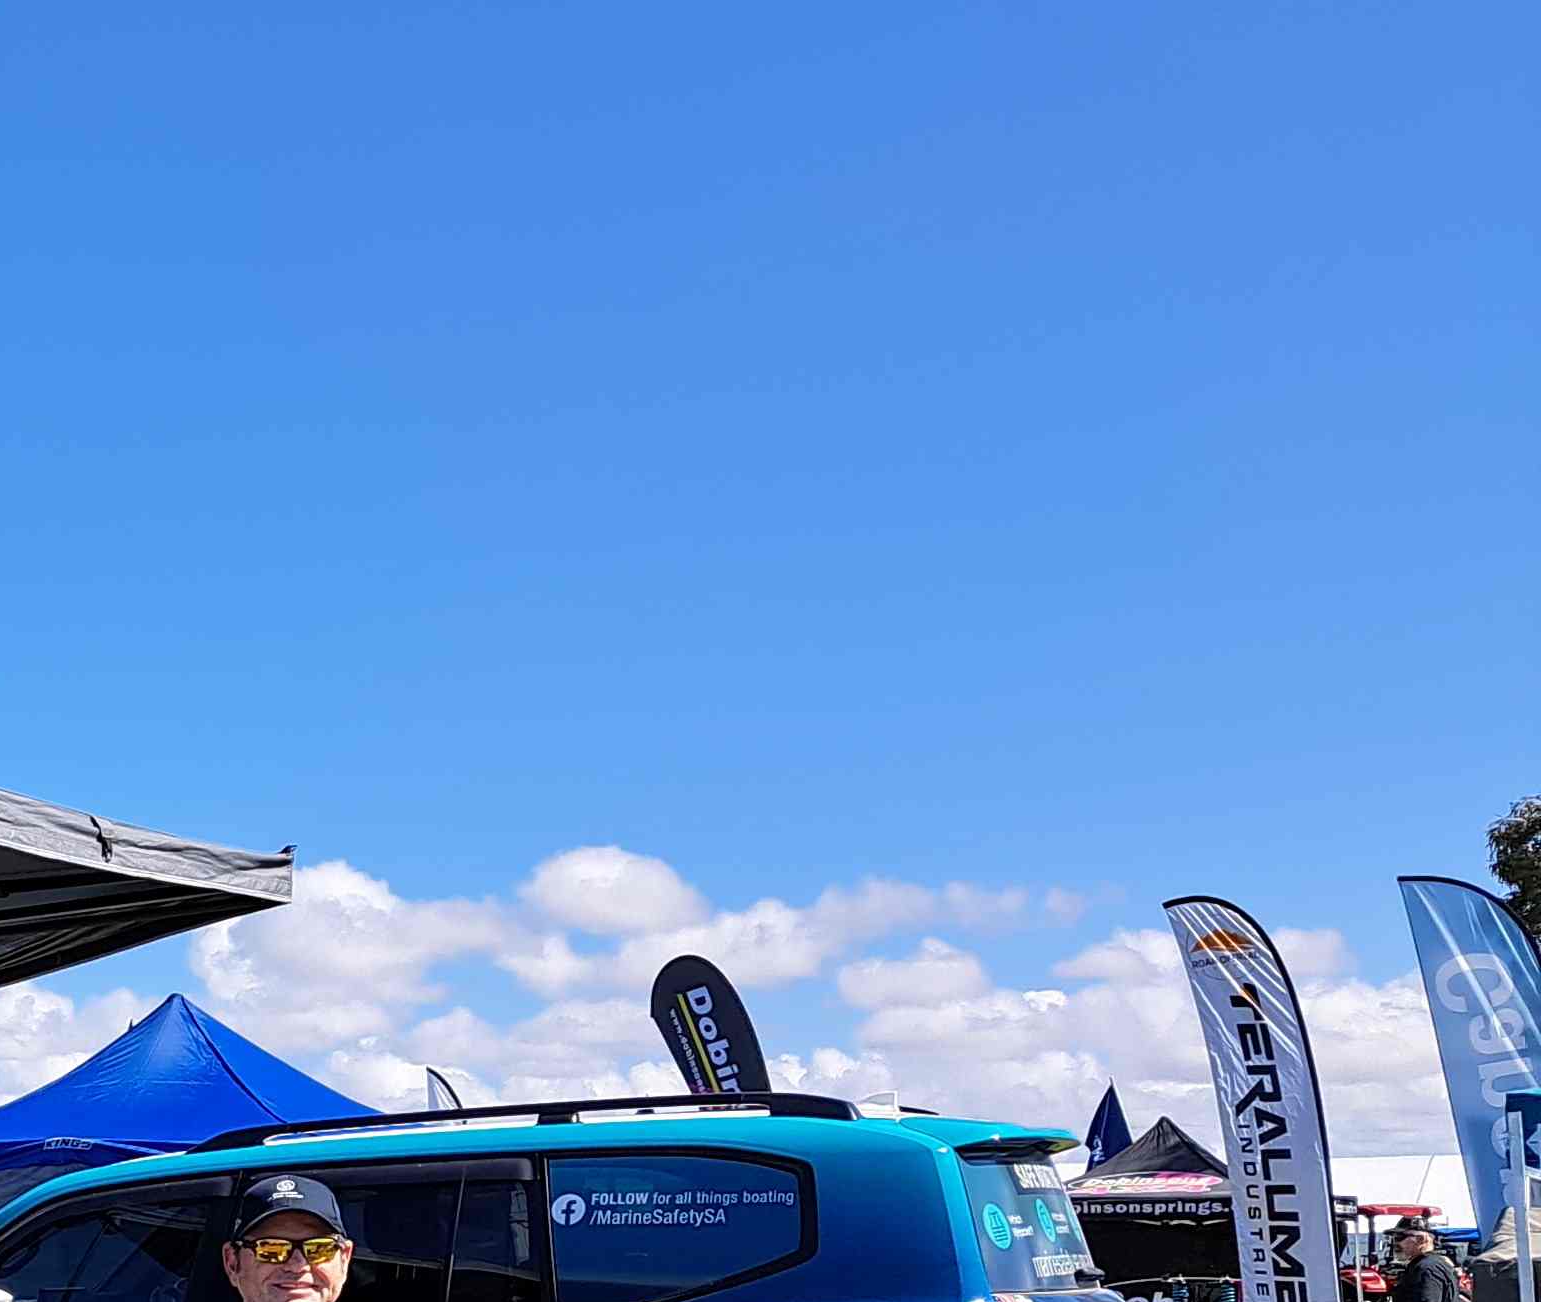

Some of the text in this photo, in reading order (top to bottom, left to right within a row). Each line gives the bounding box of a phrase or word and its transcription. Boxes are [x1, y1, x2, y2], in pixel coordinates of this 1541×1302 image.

[590, 1189, 795, 1208] FOLLOW for all things boating
[589, 1208, 726, 1227] /MarineSafetySA
